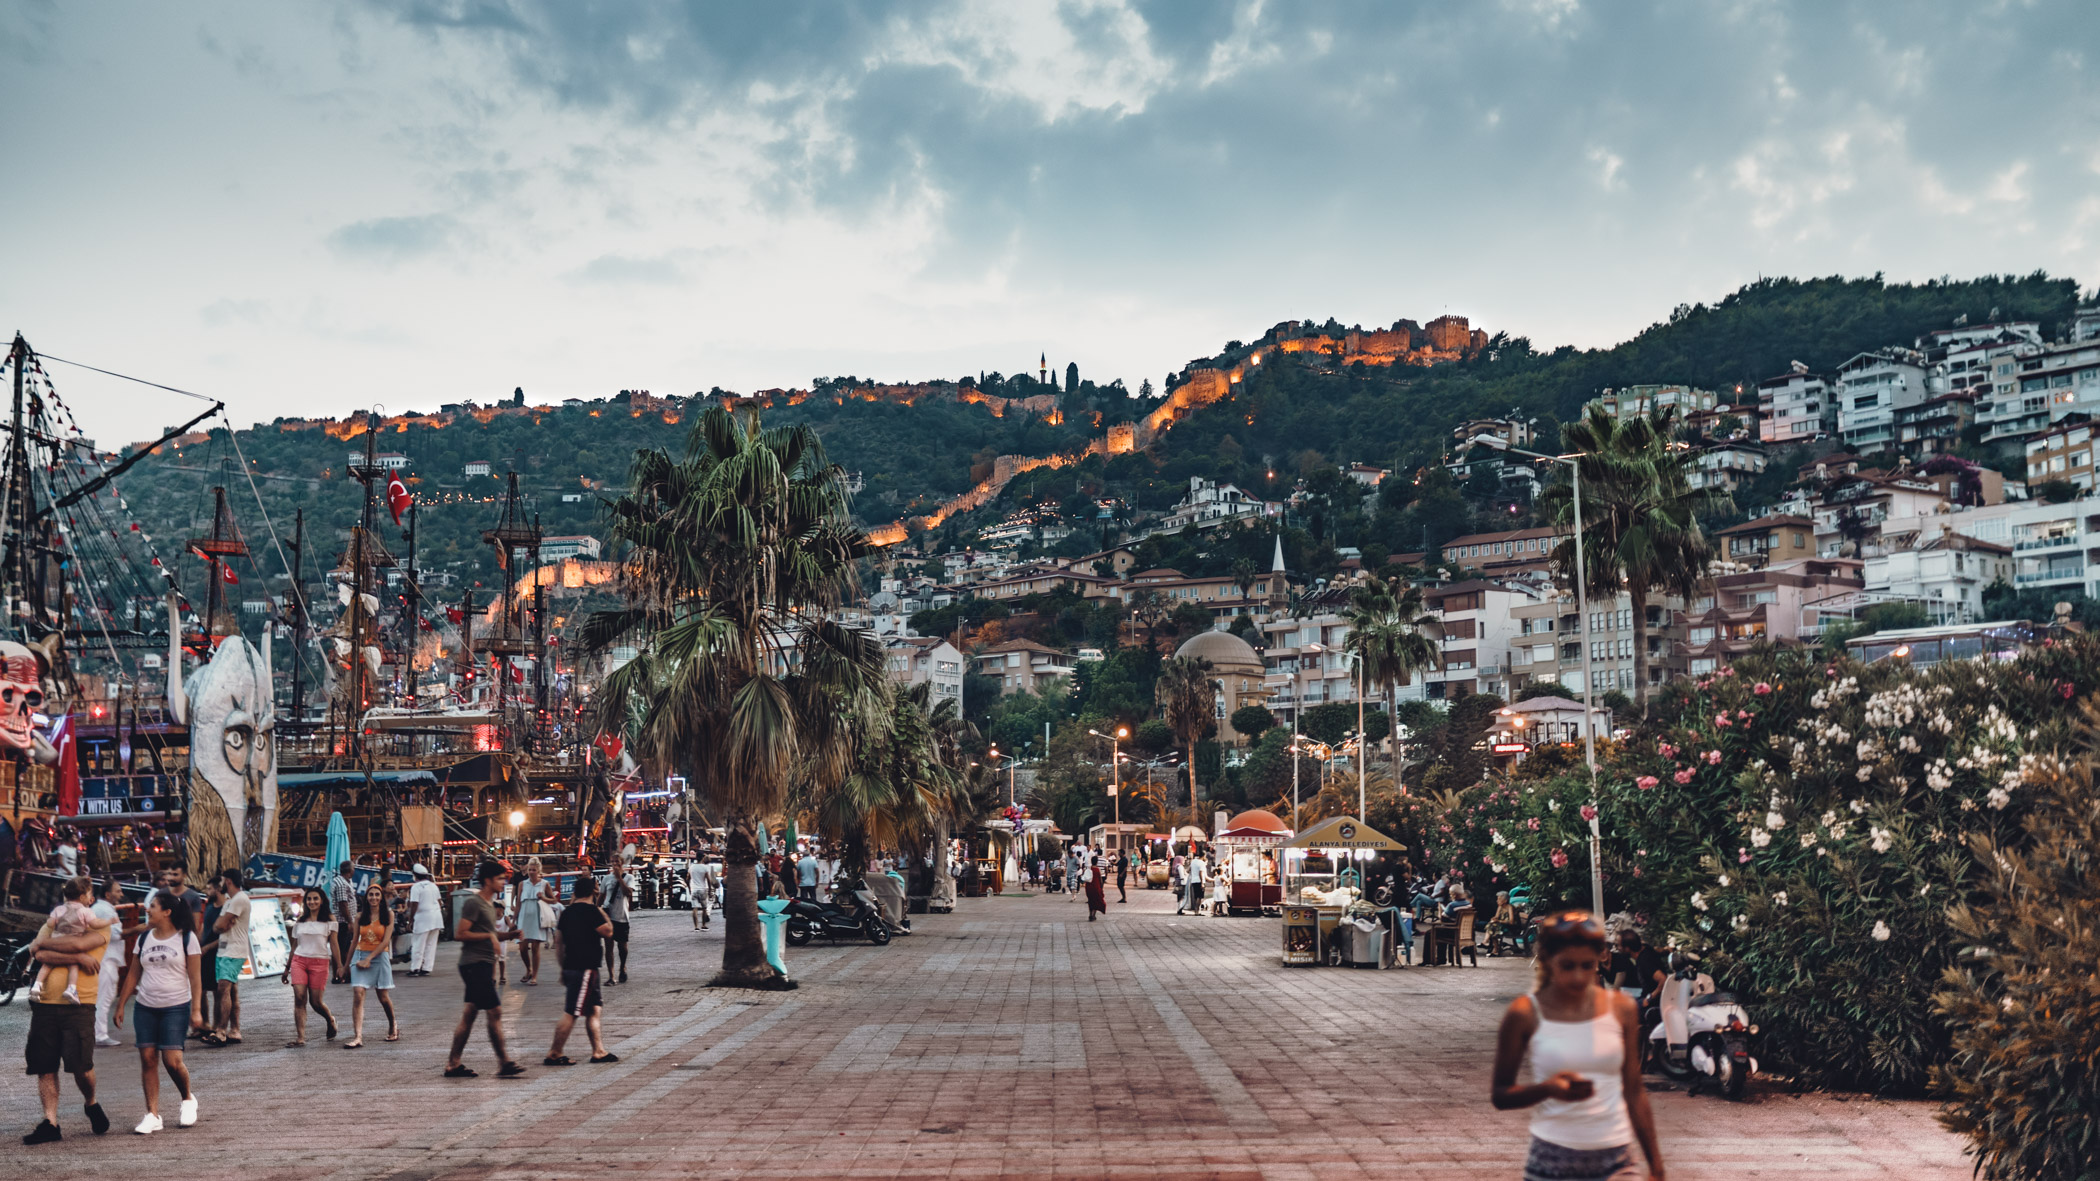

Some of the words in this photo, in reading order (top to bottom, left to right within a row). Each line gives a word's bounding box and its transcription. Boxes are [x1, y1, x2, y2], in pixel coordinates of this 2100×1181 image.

[8, 789, 39, 808] LON
[87, 799, 109, 814] WITH
[110, 799, 122, 813] US
